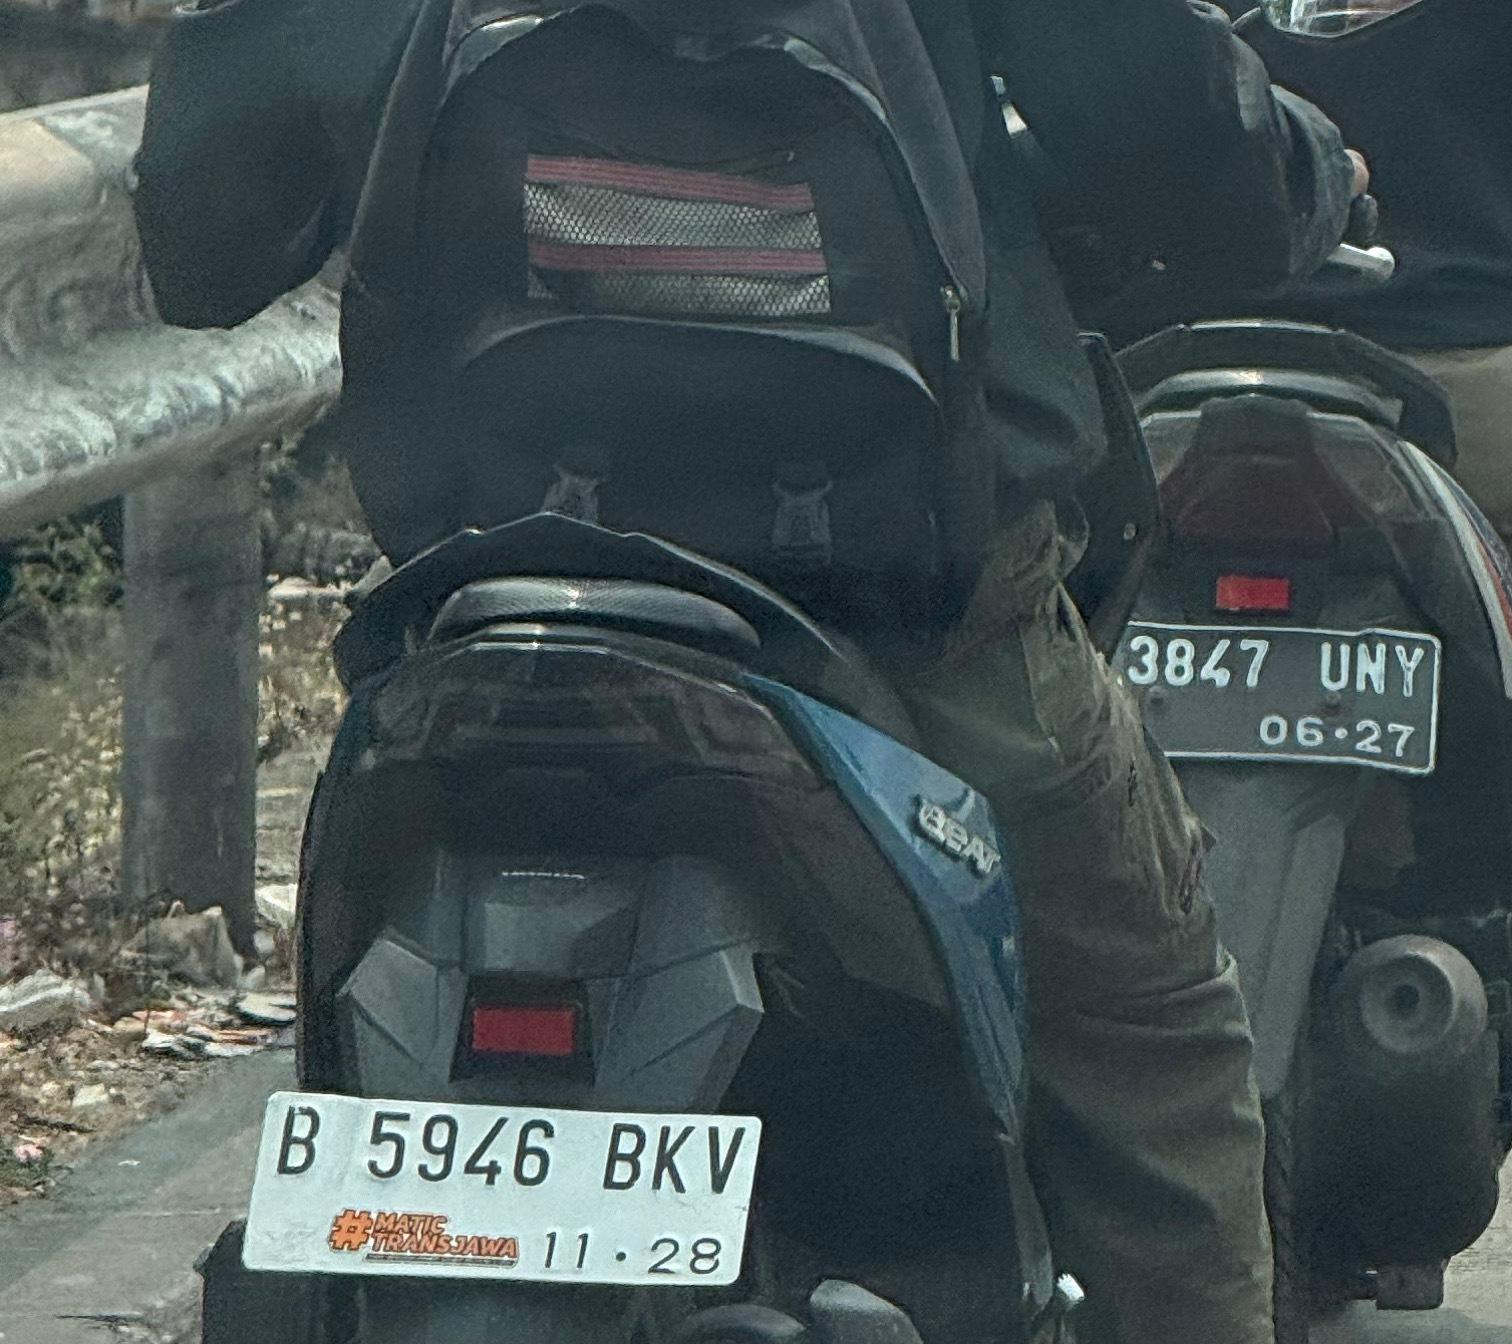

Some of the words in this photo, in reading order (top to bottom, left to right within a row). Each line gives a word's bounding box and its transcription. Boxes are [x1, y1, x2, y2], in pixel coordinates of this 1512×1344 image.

[1127, 635, 1270, 689] 3847
[1320, 641, 1425, 697] UNY
[277, 1106, 321, 1176] B
[367, 1112, 555, 1187] 5946
[602, 1122, 746, 1195] BKV
